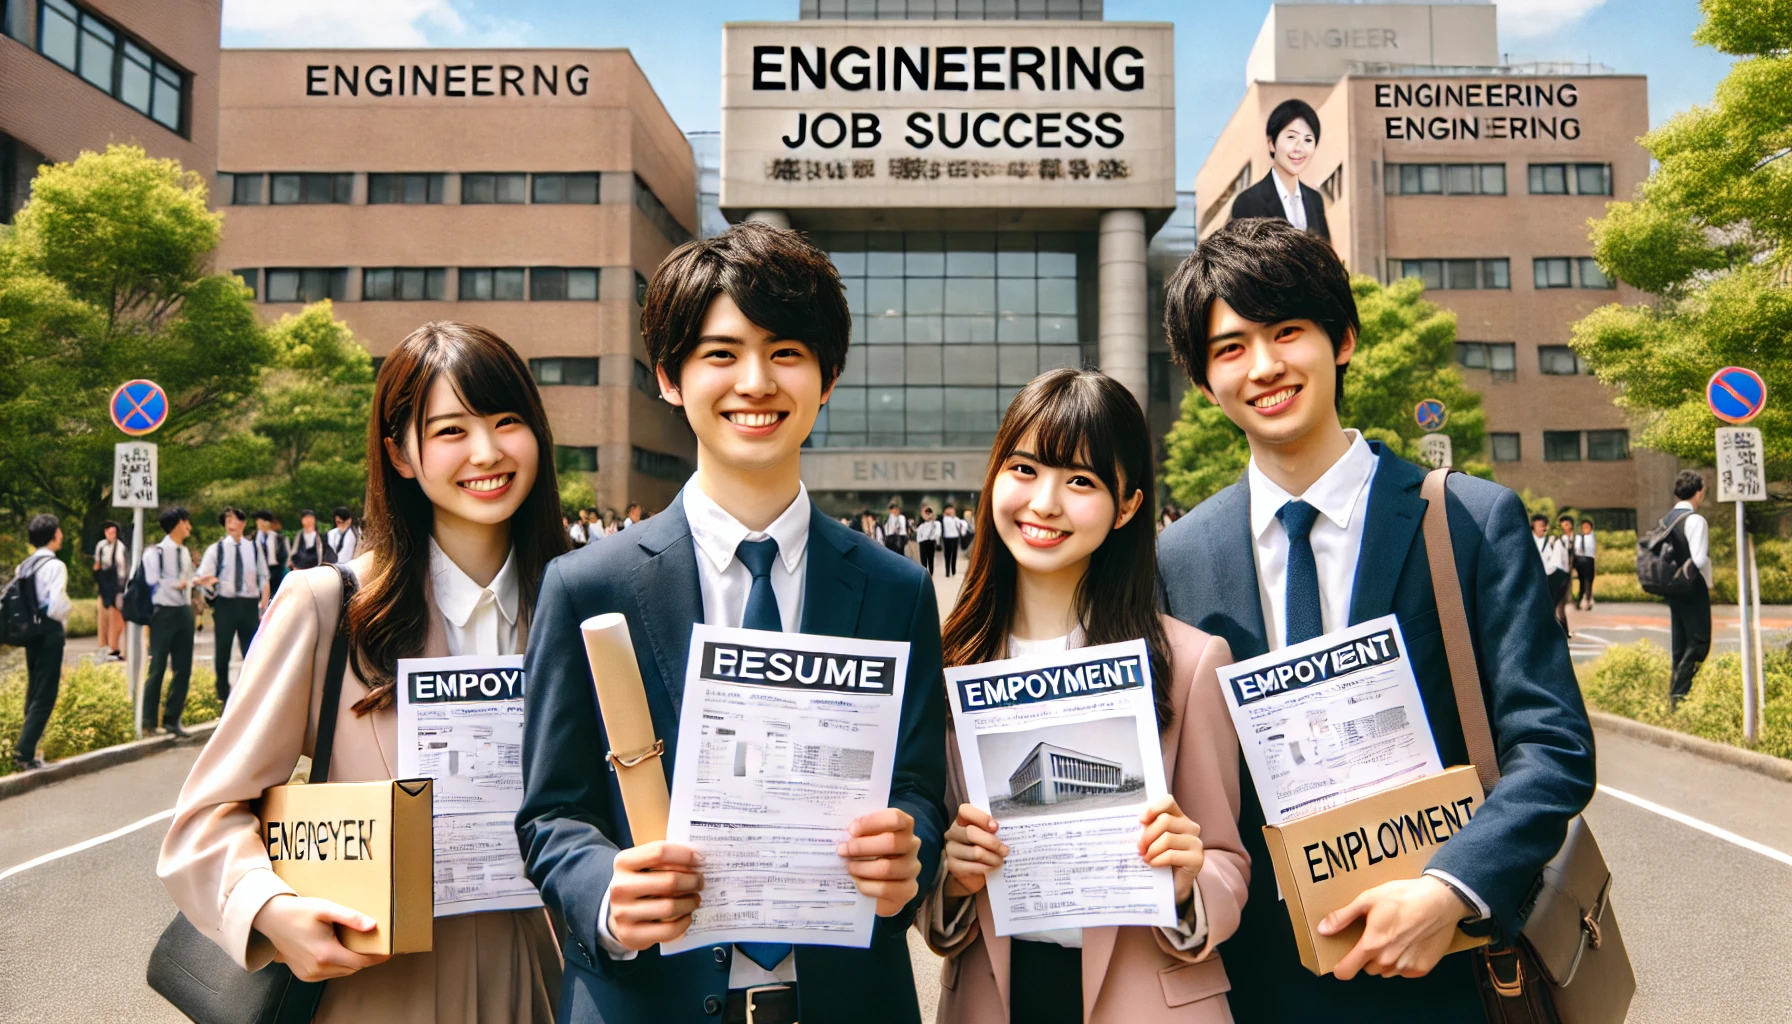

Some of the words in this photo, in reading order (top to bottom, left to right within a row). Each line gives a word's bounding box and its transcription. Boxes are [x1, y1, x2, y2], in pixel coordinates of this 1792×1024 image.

[306, 64, 589, 97] ENGINEERNG
[752, 45, 1145, 91] ENGINEERING
[1375, 83, 1578, 108] ENGINEERING
[782, 112, 882, 149] JOB
[905, 112, 1125, 149] SUCCESS
[853, 460, 956, 481] ENIVER
[416, 670, 525, 698] EMPOY
[712, 647, 885, 689] RESUME
[965, 659, 1139, 707] EMPOYMENT
[1303, 796, 1474, 883] EMPLOYMENT
